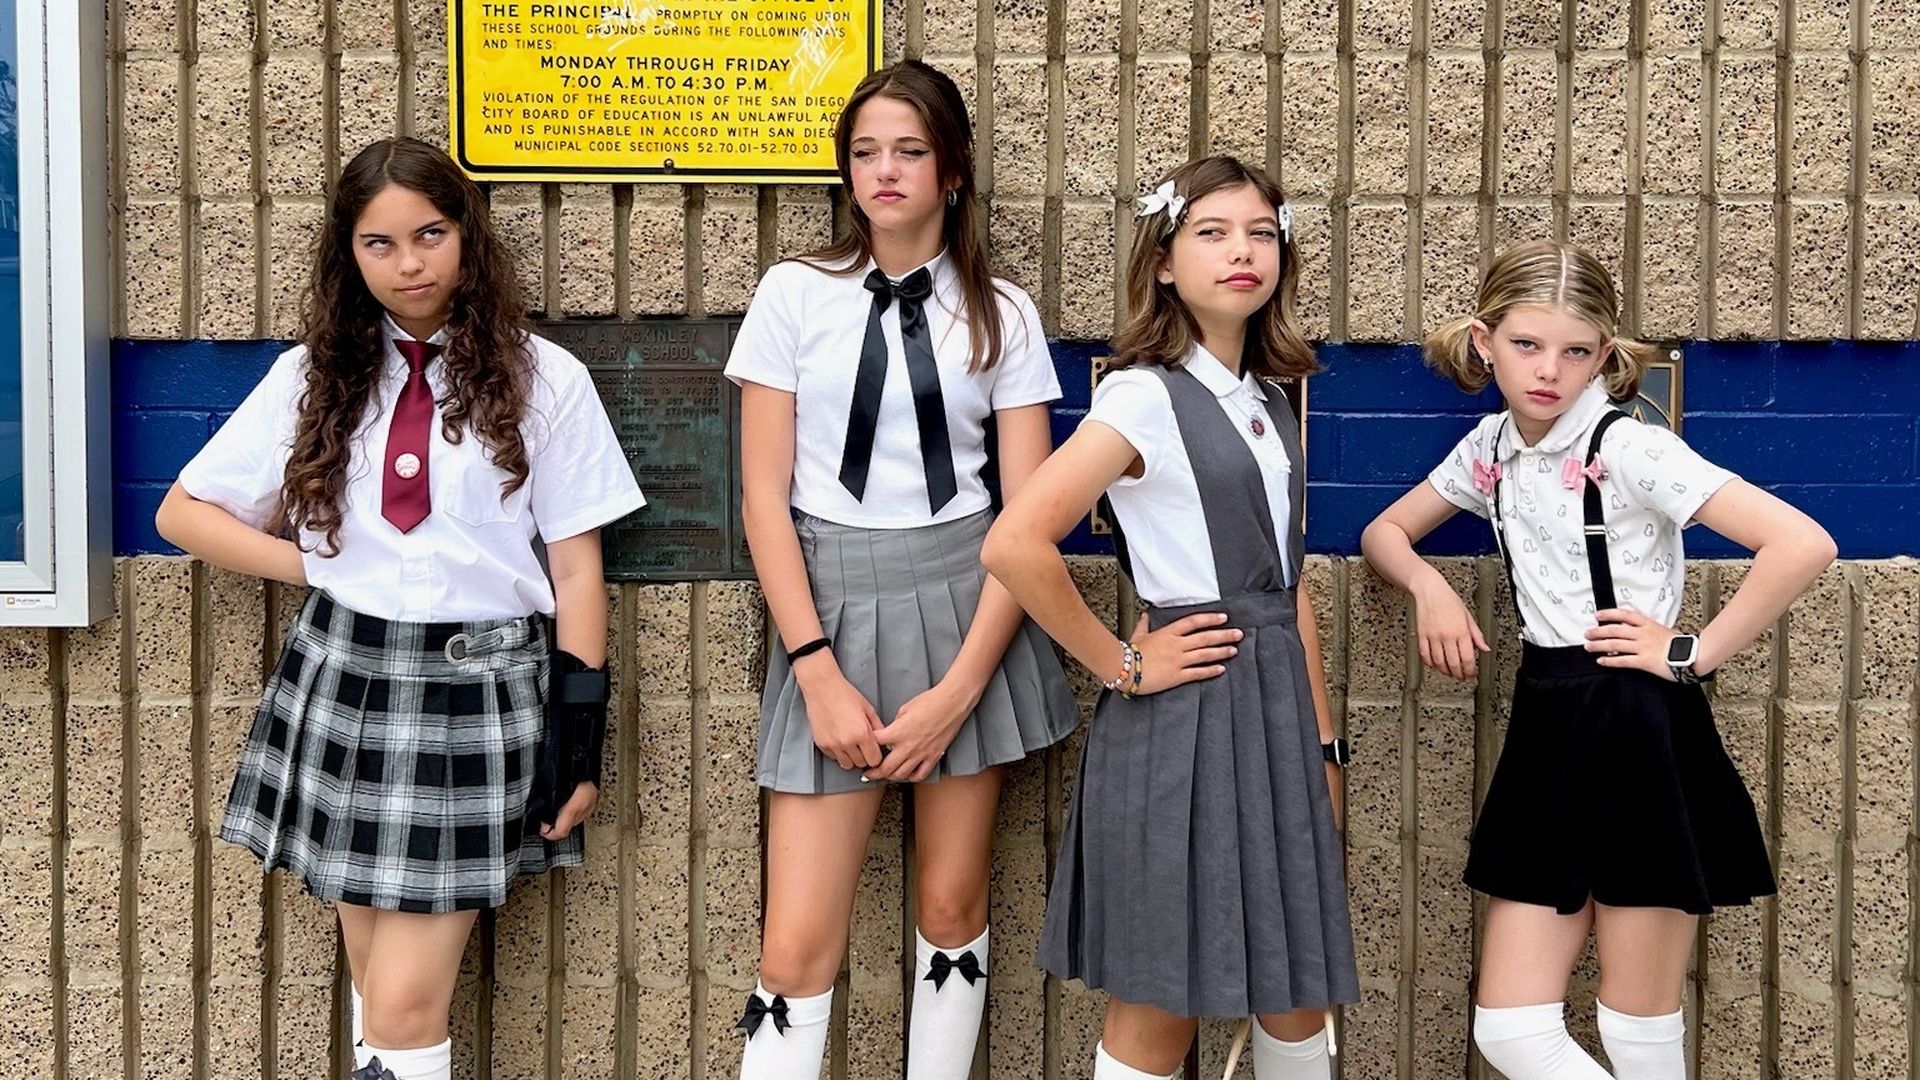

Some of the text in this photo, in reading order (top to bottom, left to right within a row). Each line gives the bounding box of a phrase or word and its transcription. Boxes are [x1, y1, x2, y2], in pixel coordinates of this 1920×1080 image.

[482, 4, 519, 18] THE
[656, 9, 723, 21] PROMPTLY
[731, 10, 749, 21] ON
[757, 10, 807, 22] COMING
[482, 23, 521, 34] THESE
[530, 23, 579, 35] SCHOOL
[654, 25, 701, 37] DURING
[708, 26, 731, 37] THE
[482, 38, 508, 50] AND
[540, 55, 791, 72] MONDAY THROUGH FRIDAY
[560, 74, 774, 91] 7:00 A.M. TO 4:30 P.M.
[482, 92, 846, 107] VIOLATION OF THE REGULATION OF THE SAN DIEGO
[482, 108, 514, 119] CITY
[523, 109, 570, 120] BOARD
[578, 109, 596, 120] OF
[604, 110, 681, 121] EDUCATION
[690, 110, 704, 121] IS
[711, 111, 730, 122] AN
[738, 112, 813, 122] UNLAWFUL
[484, 124, 836, 138] AND IS PUNISHABLE IN ACCORD WITH SAN DIEG
[514, 140, 819, 154] MUNICIPAL CODE SECTIONS 52.70.01-52.70.03
[641, 344, 699, 361] SCHOOL
